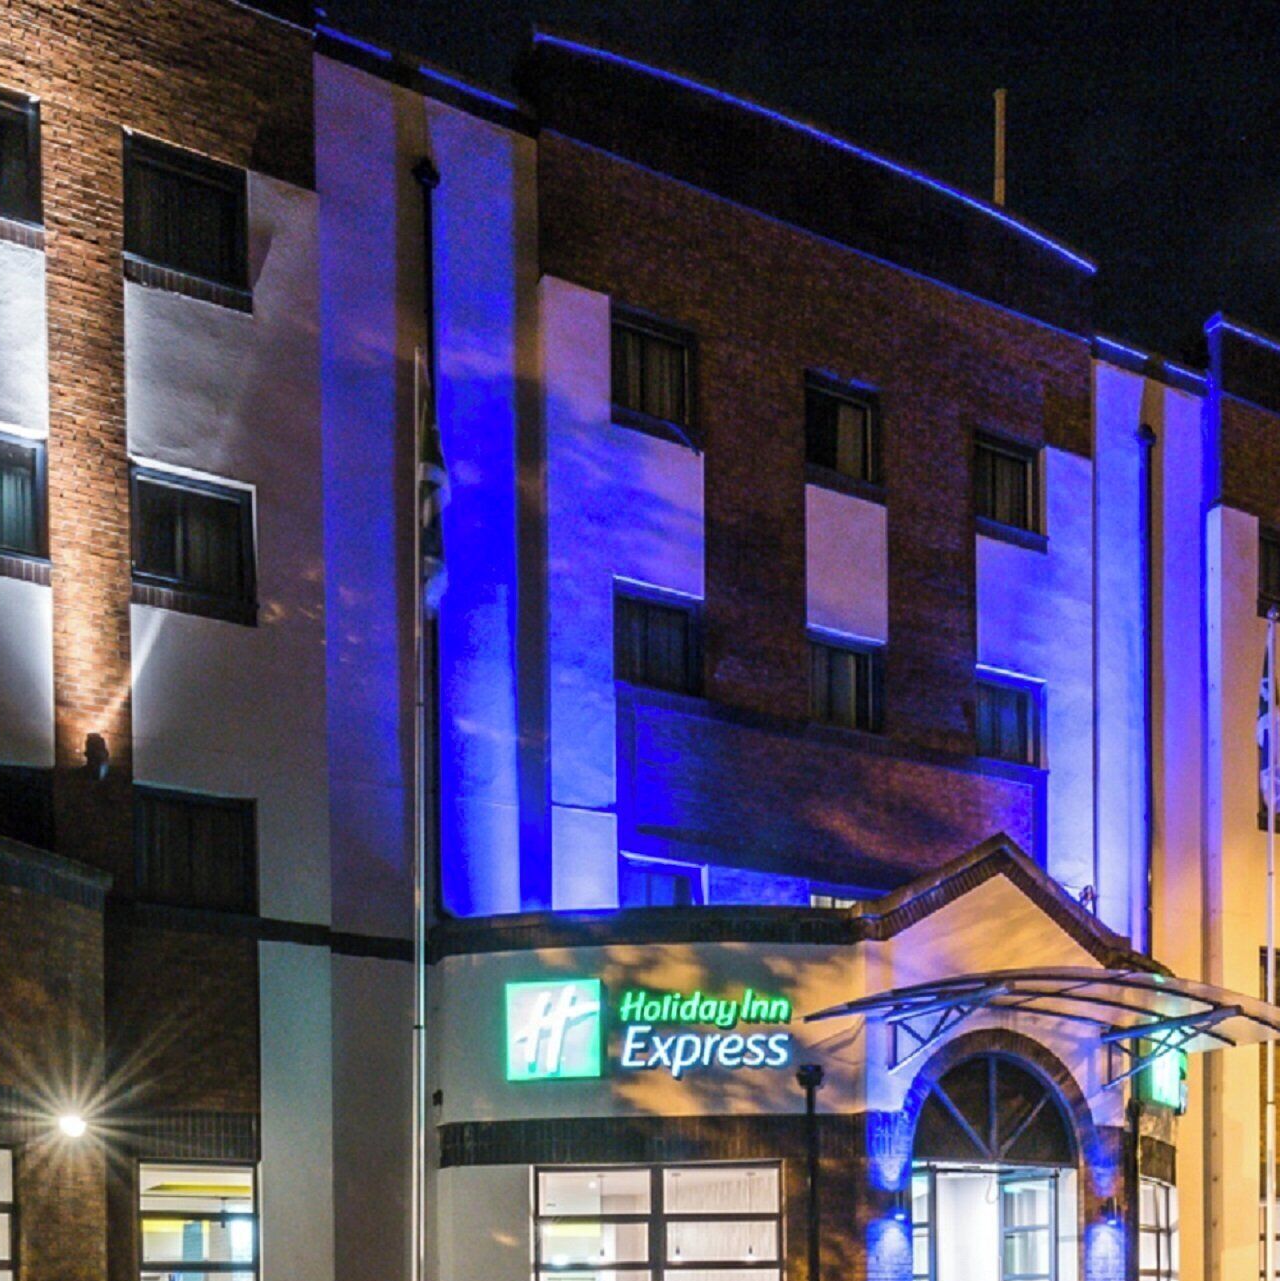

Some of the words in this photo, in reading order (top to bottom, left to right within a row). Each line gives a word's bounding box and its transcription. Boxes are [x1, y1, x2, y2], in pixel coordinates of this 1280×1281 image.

[620, 991, 735, 1025] Holiday
[740, 989, 790, 1021] Inn
[622, 1025, 789, 1077] Express
